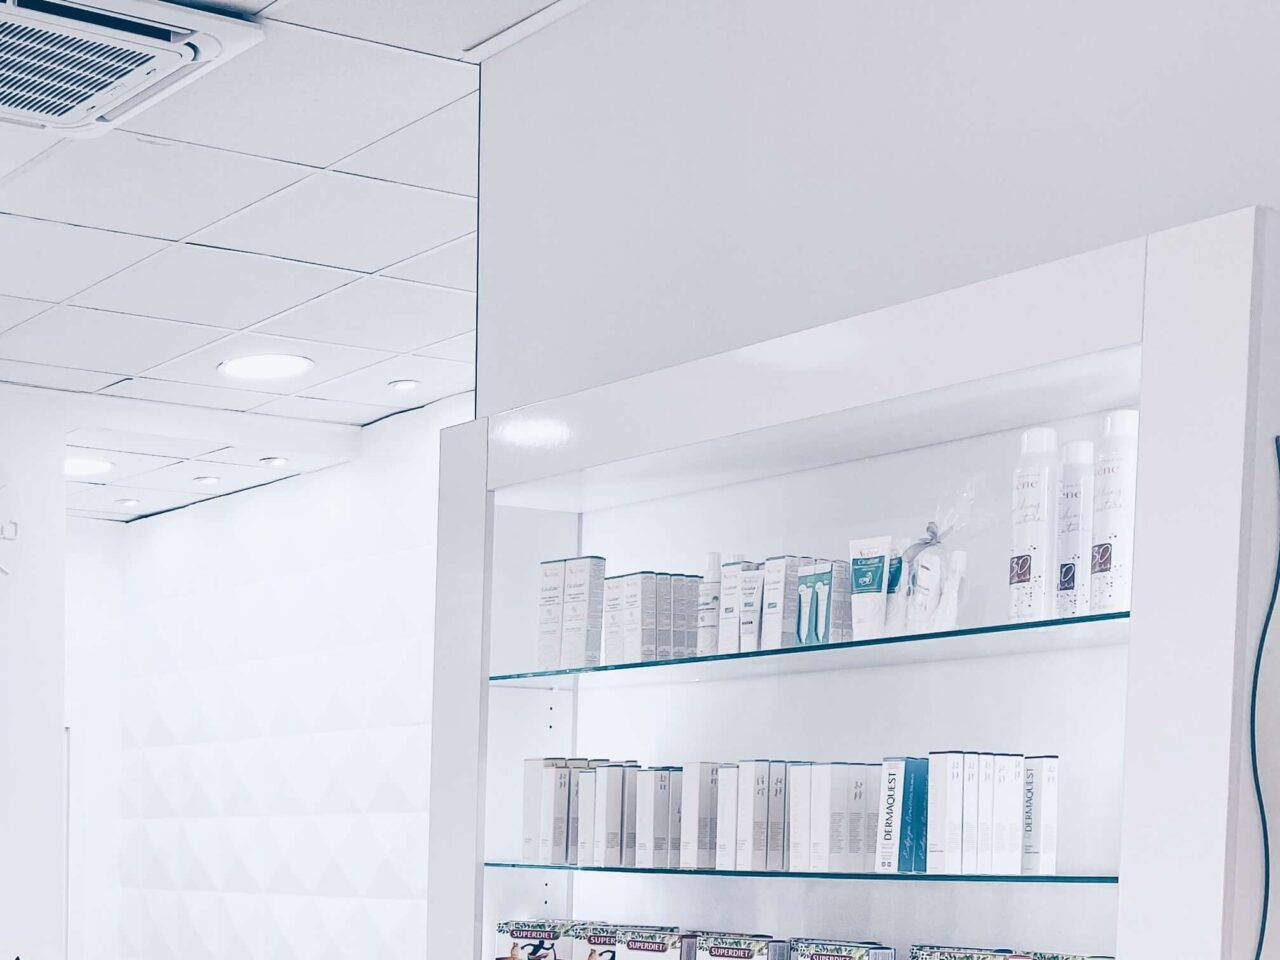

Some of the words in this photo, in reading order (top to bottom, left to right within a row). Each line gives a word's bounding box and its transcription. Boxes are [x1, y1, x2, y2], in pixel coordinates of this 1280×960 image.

[1025, 767, 1035, 833] DERMAQUEST
[883, 771, 898, 842] DERMAQUEST
[512, 930, 555, 940] SUPERDIET
[590, 936, 616, 944] SUPER
[628, 941, 665, 951] SUPERDIET
[711, 947, 750, 958] SUPERDIET
